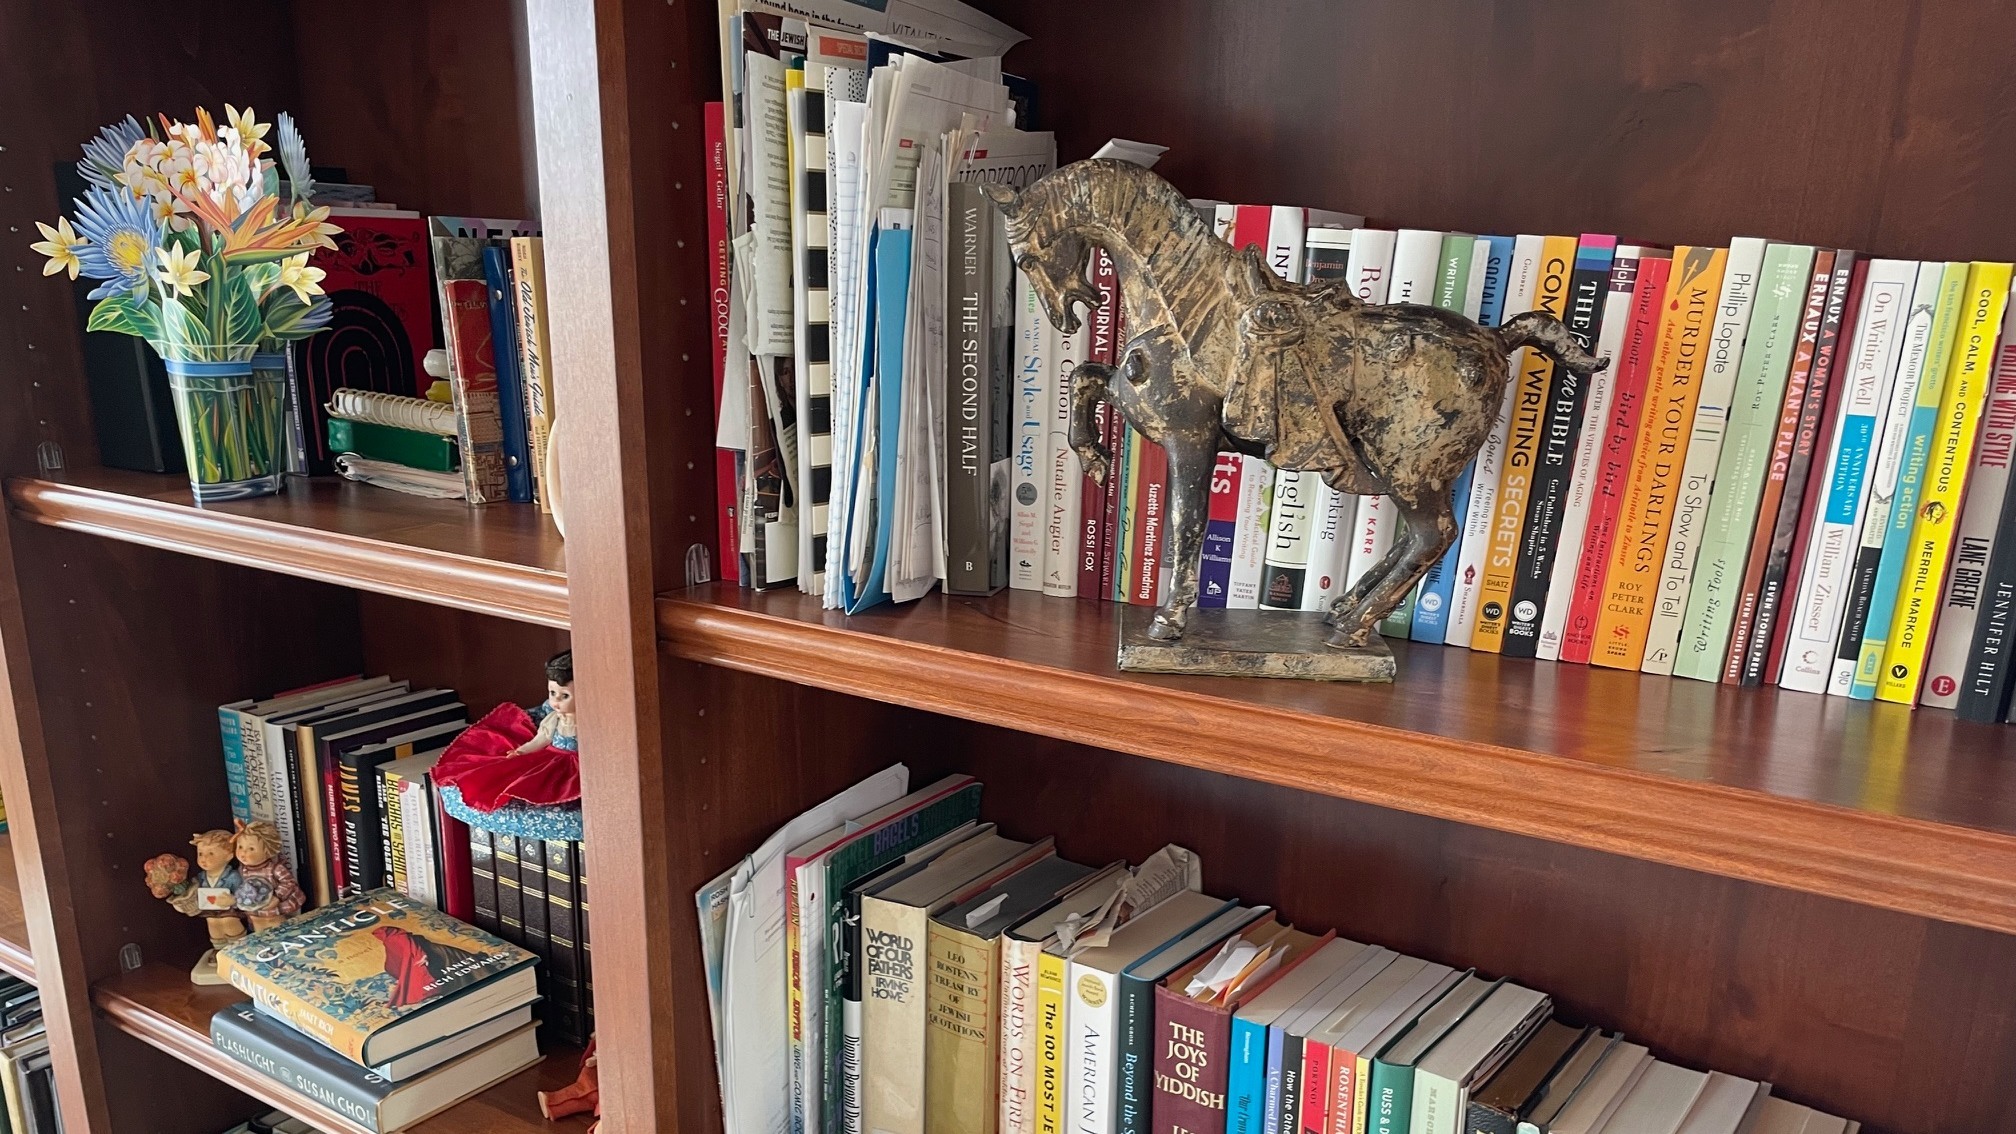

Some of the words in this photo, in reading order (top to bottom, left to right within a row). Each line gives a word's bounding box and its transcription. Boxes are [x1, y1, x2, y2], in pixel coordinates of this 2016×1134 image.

[768, 28, 780, 42] THE
[780, 32, 806, 46] JEWISH
[714, 142, 722, 171] Siegel
[964, 207, 977, 276] WARNER
[1099, 248, 1113, 277] 365
[520, 280, 533, 306] Old
[1442, 257, 1459, 308] WRITING
[1721, 272, 1752, 318] Phillip
[1826, 269, 1849, 324] ERNAUX
[963, 292, 978, 333] THE
[1572, 281, 1598, 330] THE
[1802, 273, 1830, 342] ERNAUX
[1874, 292, 1892, 314] On
[523, 309, 538, 350] Jewish
[1094, 282, 1112, 355] JOURNAL
[1668, 319, 1676, 340] And
[1024, 329, 1031, 340] OF
[1673, 286, 1708, 387] MURDER
[1713, 322, 1741, 374] Lopate
[1824, 330, 1834, 338] A
[1858, 318, 1888, 371] Writing
[528, 348, 540, 380] Men's
[1661, 341, 1670, 366] other
[1752, 391, 1762, 410] ROY
[1757, 358, 1770, 386] PETER
[1766, 314, 1780, 348] CLARK
[1798, 353, 1808, 362] A
[962, 339, 978, 421] SECOND
[1654, 366, 1666, 394] gentle
[1808, 346, 1832, 410] WOMAN'S
[1856, 376, 1876, 406] Well
[528, 382, 544, 416] Guide
[1592, 378, 1606, 410] CARTER
[1784, 370, 1808, 424] MAN'S
[1590, 414, 1599, 432] THE
[1616, 392, 1636, 429] bird
[1645, 394, 1658, 429] writing
[1990, 396, 2015, 429] WITH
[1546, 399, 1574, 466] BIBLE
[1658, 396, 1688, 456] YOUR
[1798, 414, 1816, 456] STORY
[961, 427, 978, 476] HALF
[1582, 433, 1597, 467] VIRTUES
[1608, 432, 1628, 455] by
[1639, 430, 1650, 459] advice
[1770, 431, 1795, 482] PLACE
[1980, 429, 2013, 468] STYLE
[1054, 448, 1068, 501] Natalie
[1580, 469, 1589, 482] OF
[1602, 462, 1622, 498] bird
[1634, 459, 1646, 482] from
[1688, 474, 1708, 491] To
[1148, 483, 1161, 517] Suzette
[1472, 483, 1484, 508] Writer
[1550, 478, 1559, 495] Get
[1573, 482, 1586, 508] AGING
[1533, 500, 1544, 526] Susan
[1540, 496, 1556, 536] Published
[1626, 484, 1642, 522] Aristotle
[1634, 462, 1672, 574] DARLINGS
[1676, 495, 1702, 538] Show
[1050, 504, 1066, 555] Angier
[1086, 520, 1096, 548] ROSSI
[1144, 517, 1159, 556] Martinez
[1207, 534, 1232, 542] Allison
[1468, 510, 1478, 538] Within
[1625, 524, 1634, 533] to
[1528, 526, 1540, 556] Shapiro
[1540, 538, 1546, 547] in
[1618, 536, 1632, 566] Zinsser
[1670, 541, 1689, 570] and
[1818, 528, 1844, 580] William
[1958, 536, 1990, 567] LANE
[1085, 552, 1094, 572] FOX
[1532, 556, 1546, 580] Weeks
[1914, 540, 1935, 592] MERRILL
[1140, 558, 1156, 600] Standring
[1486, 580, 1509, 588] SHATZ
[1618, 581, 1642, 592] ROY
[1666, 576, 1684, 592] To
[1949, 568, 1982, 610] GREENE
[1608, 604, 1644, 616] CLARK
[1612, 592, 1644, 604] PETER
[1660, 595, 1682, 618] Tell
[1808, 584, 1832, 632] Zinsser
[1509, 629, 1534, 637] BOOKS
[1902, 598, 1922, 649] MARKOE
[1984, 582, 2014, 655] JENNIFER
[1795, 666, 1821, 676] Collins
[1974, 662, 1995, 696] HILT
[245, 720, 254, 747] THE
[254, 730, 263, 758] ISABEL
[248, 750, 259, 790] HOUSE
[257, 760, 268, 802] ALLENDE
[254, 791, 263, 810] OF
[328, 784, 336, 817] MURDER
[345, 820, 360, 876] PERCIVAL
[383, 840, 392, 872] GOLEM
[386, 874, 394, 888] OF
[256, 898, 410, 964] CANTICLE
[866, 927, 914, 952] WORLD
[441, 956, 476, 974] JANET
[866, 944, 884, 960] OF
[884, 948, 912, 966] OUR
[868, 958, 914, 980] FATHERS
[946, 952, 966, 965] LEO
[422, 975, 454, 993] RICH
[454, 951, 510, 980] EDWARDS
[876, 976, 909, 994] IRVING
[934, 974, 980, 998] TREASURY
[936, 960, 978, 982] ROSTEN'S
[230, 970, 292, 1018] CANTICLE
[300, 1009, 318, 1026] JANET
[318, 1018, 334, 1035] RICH
[871, 986, 905, 1003] HOWE
[948, 994, 961, 1004] OF
[1010, 963, 1030, 1040] WORDS
[929, 1013, 986, 1040] QUOTATIONS
[938, 1004, 972, 1023] JEWISH
[1044, 1003, 1056, 1030] The
[1044, 1036, 1056, 1061] 100
[1168, 1021, 1205, 1048] THE
[1010, 1048, 1024, 1078] ON
[1166, 1040, 1208, 1068] JOYS
[216, 1032, 276, 1076] FLASHLIGHT
[296, 1074, 336, 1106] SUSAN
[336, 1096, 372, 1124] CHOI
[1082, 1024, 1100, 1122] AMERICAN
[1124, 1052, 1138, 1095] Beyond
[1175, 1062, 1200, 1083] OF
[1270, 1066, 1280, 1075] A
[1286, 1070, 1296, 1092] How
[1310, 1060, 1319, 1104] PORTNOY
[1044, 1066, 1056, 1112] MOST
[1154, 1070, 1226, 1110] YIDDISH
[1268, 1077, 1279, 1120] Charmed
[1284, 1094, 1294, 1110] the
[1380, 1087, 1394, 1116] RUSS
[1009, 1086, 1027, 1129] FIRE
[1124, 1099, 1136, 1120] the
[1282, 1113, 1294, 1134] Othe
